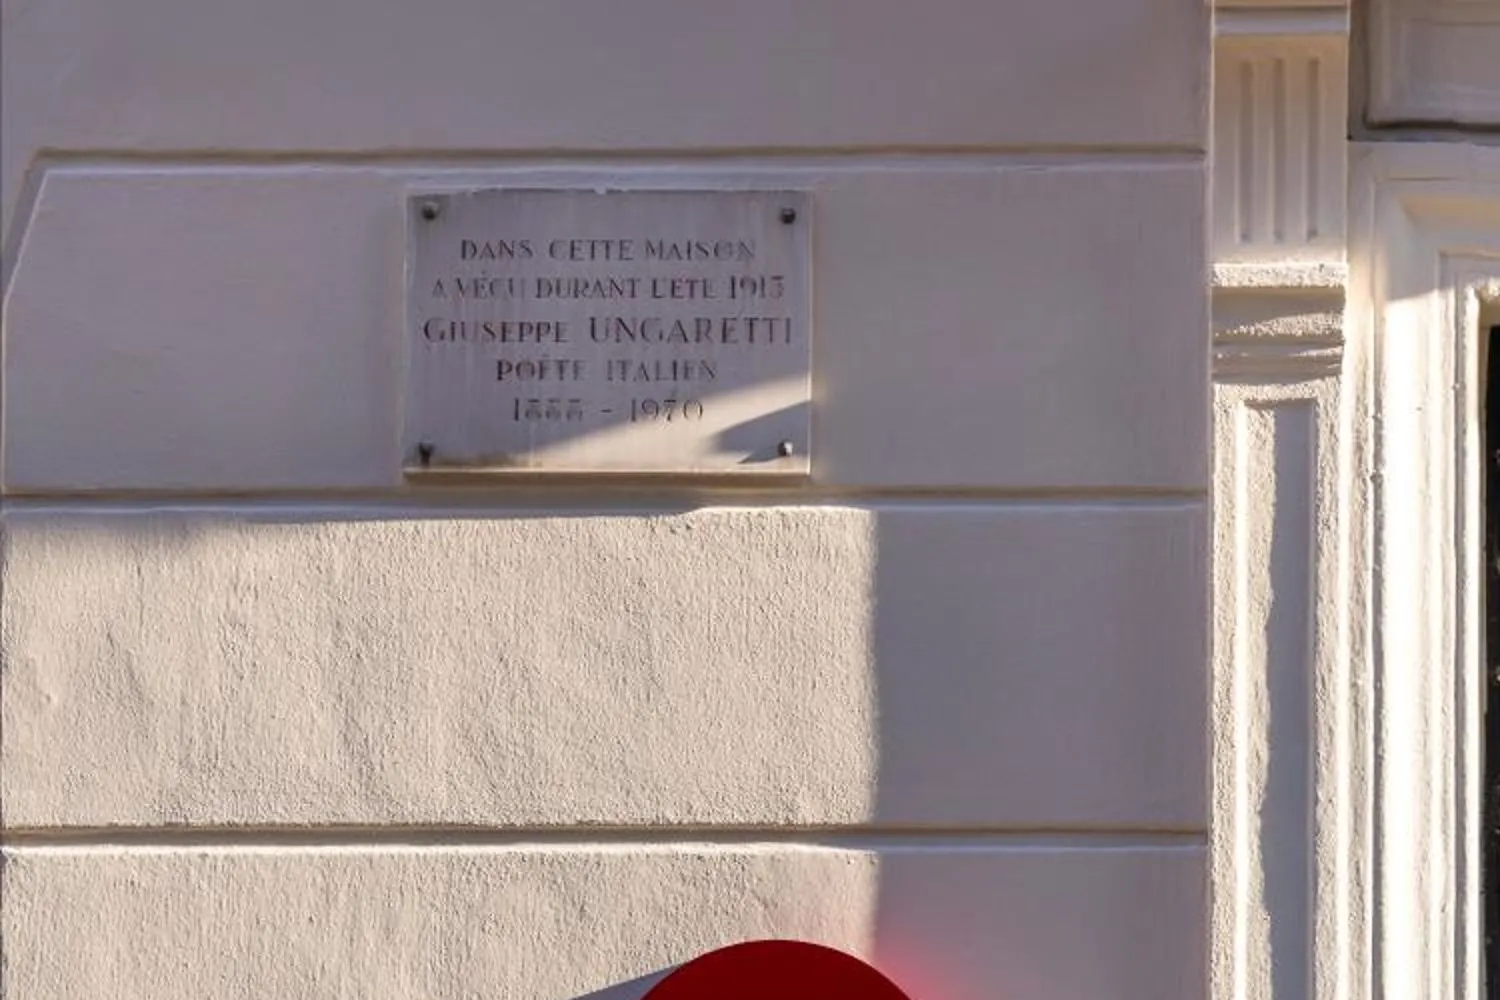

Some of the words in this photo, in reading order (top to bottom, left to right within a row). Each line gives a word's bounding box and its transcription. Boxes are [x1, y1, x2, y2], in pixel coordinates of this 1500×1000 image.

[460, 238, 533, 262] DANS
[548, 238, 634, 262] CETTE
[644, 238, 756, 262] MAISON
[535, 276, 641, 300] DURANT
[422, 317, 570, 344] GIUSEPPE
[589, 316, 793, 345] UNGARETTI
[606, 359, 718, 382] ITALIEN
[631, 397, 704, 423] 1970
